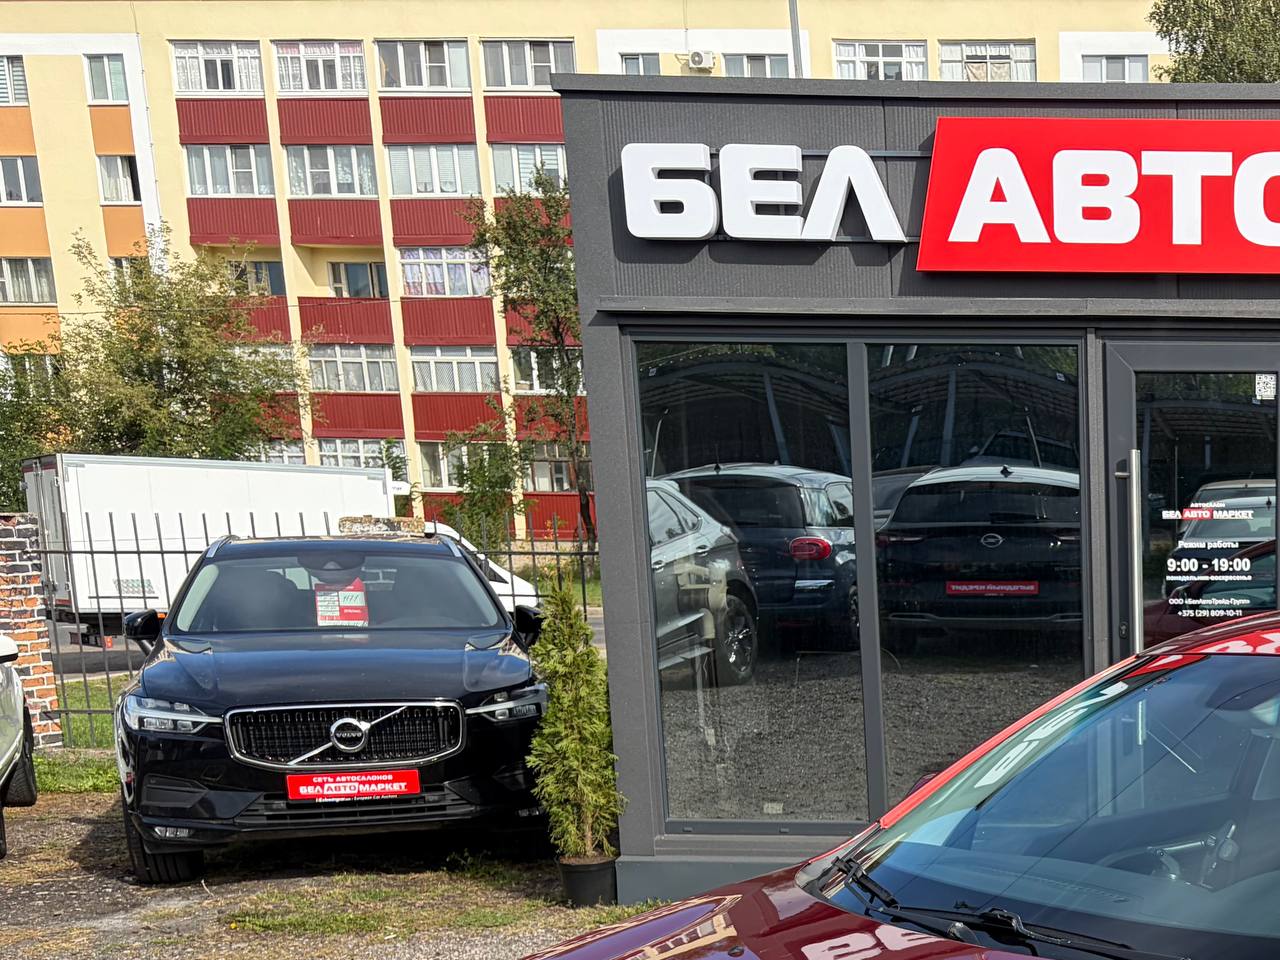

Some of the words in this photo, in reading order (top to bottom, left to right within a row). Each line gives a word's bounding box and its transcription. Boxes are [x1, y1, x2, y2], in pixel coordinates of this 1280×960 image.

[621, 142, 907, 241] БЕЛ
[1162, 510, 1182, 519] БЕЛ
[1184, 510, 1210, 518] АВТО
[1213, 510, 1254, 519] МАРКЕТ
[1207, 540, 1239, 550] работы
[1167, 558, 1198, 572] 9:00
[1211, 558, 1251, 572] 19:00
[1178, 609, 1195, 617] +375
[1195, 609, 1210, 618] (29)
[1210, 609, 1243, 617] 809-10-11
[336, 774, 393, 783] АВТОСАЛОНОВ
[299, 785, 323, 795] БЕЛ
[325, 784, 357, 794] АВТО
[360, 782, 408, 793] МАРКЕТ
